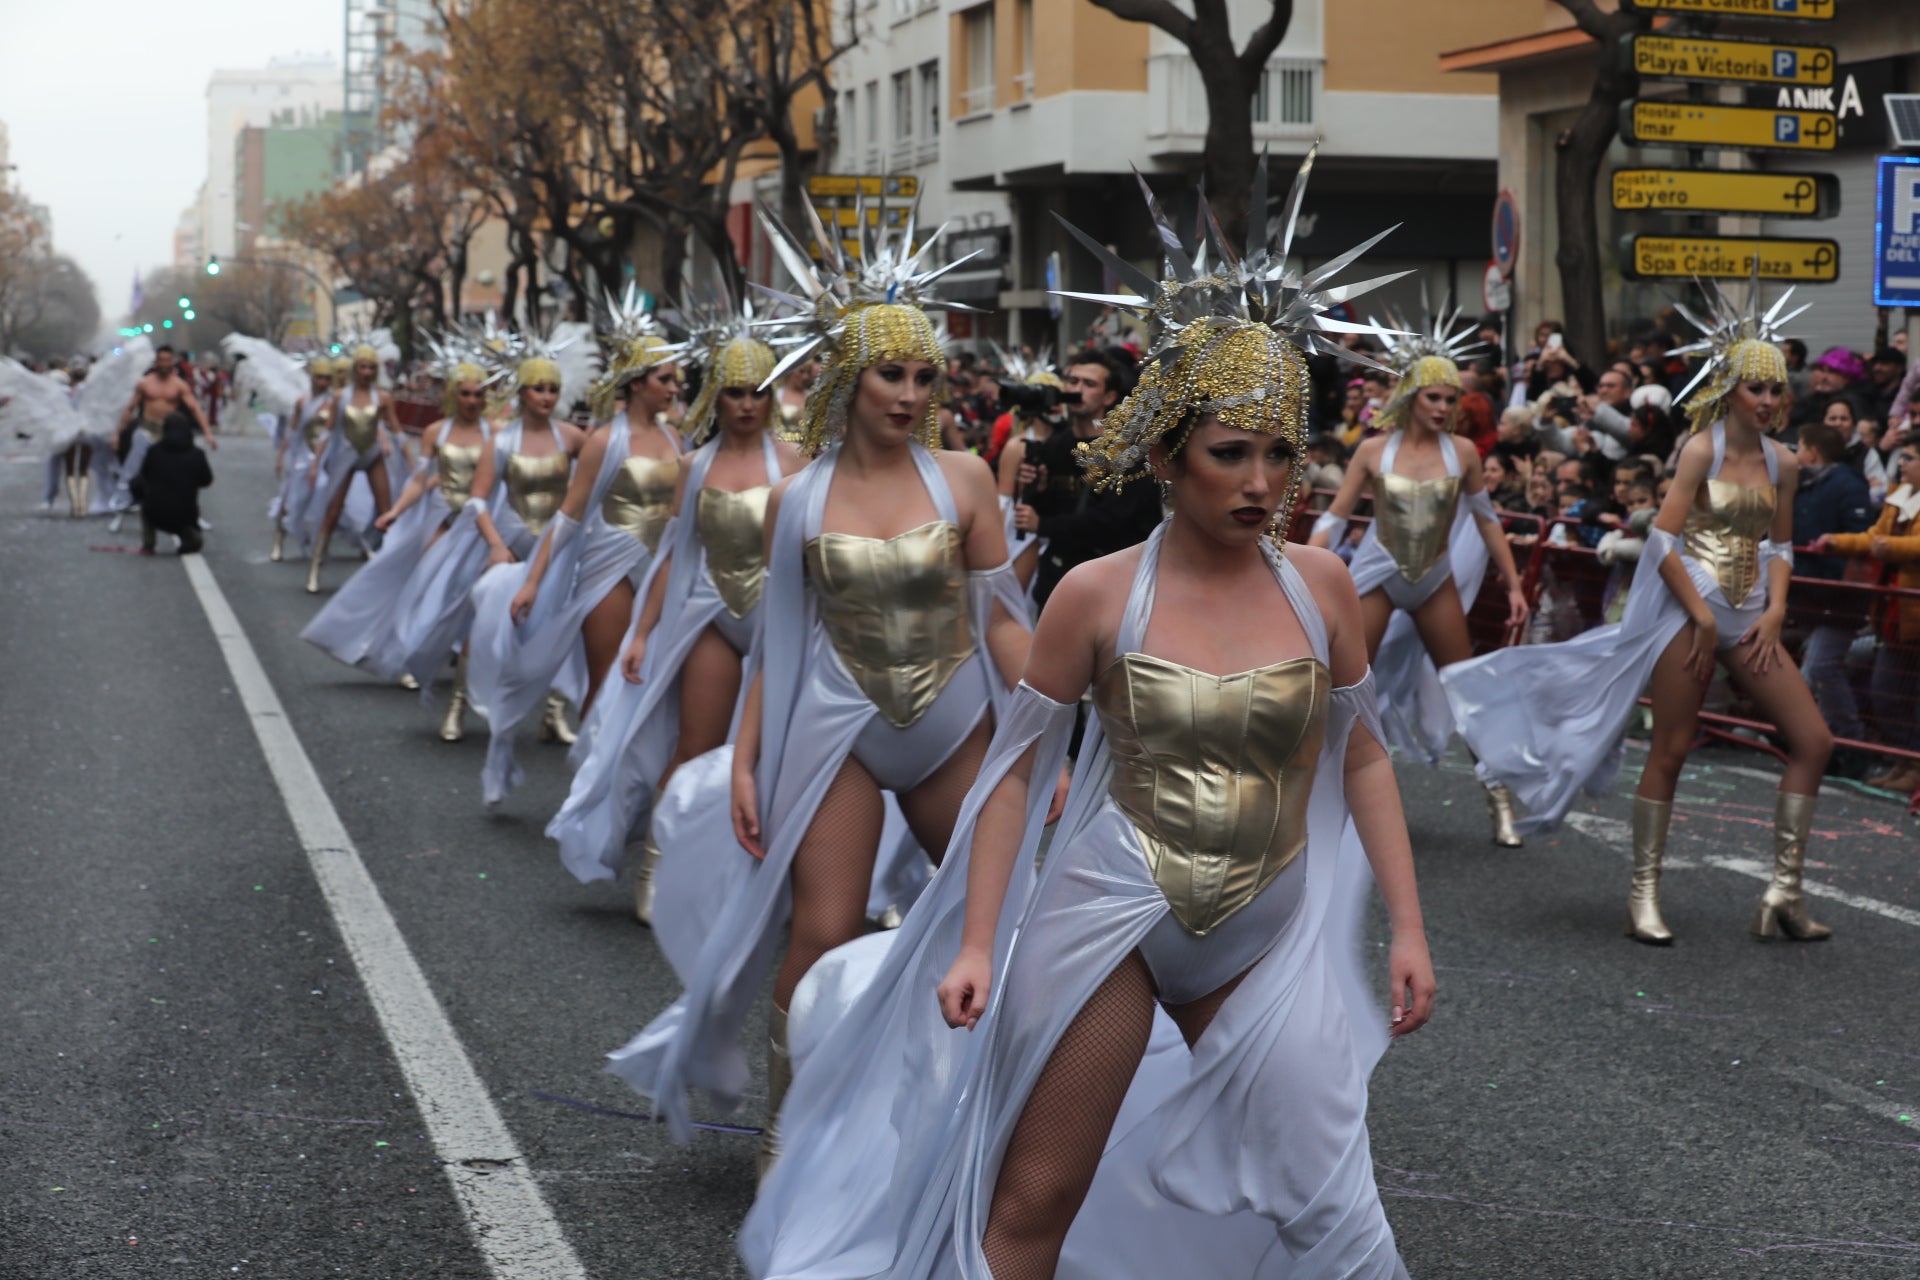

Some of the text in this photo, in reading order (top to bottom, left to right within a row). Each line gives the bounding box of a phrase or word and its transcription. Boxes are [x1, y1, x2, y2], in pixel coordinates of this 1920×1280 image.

[1638, 52, 1688, 75] Playa
[1696, 55, 1769, 77] Victoria
[1616, 188, 1689, 209] Playero
[1641, 254, 1676, 274] Spa
